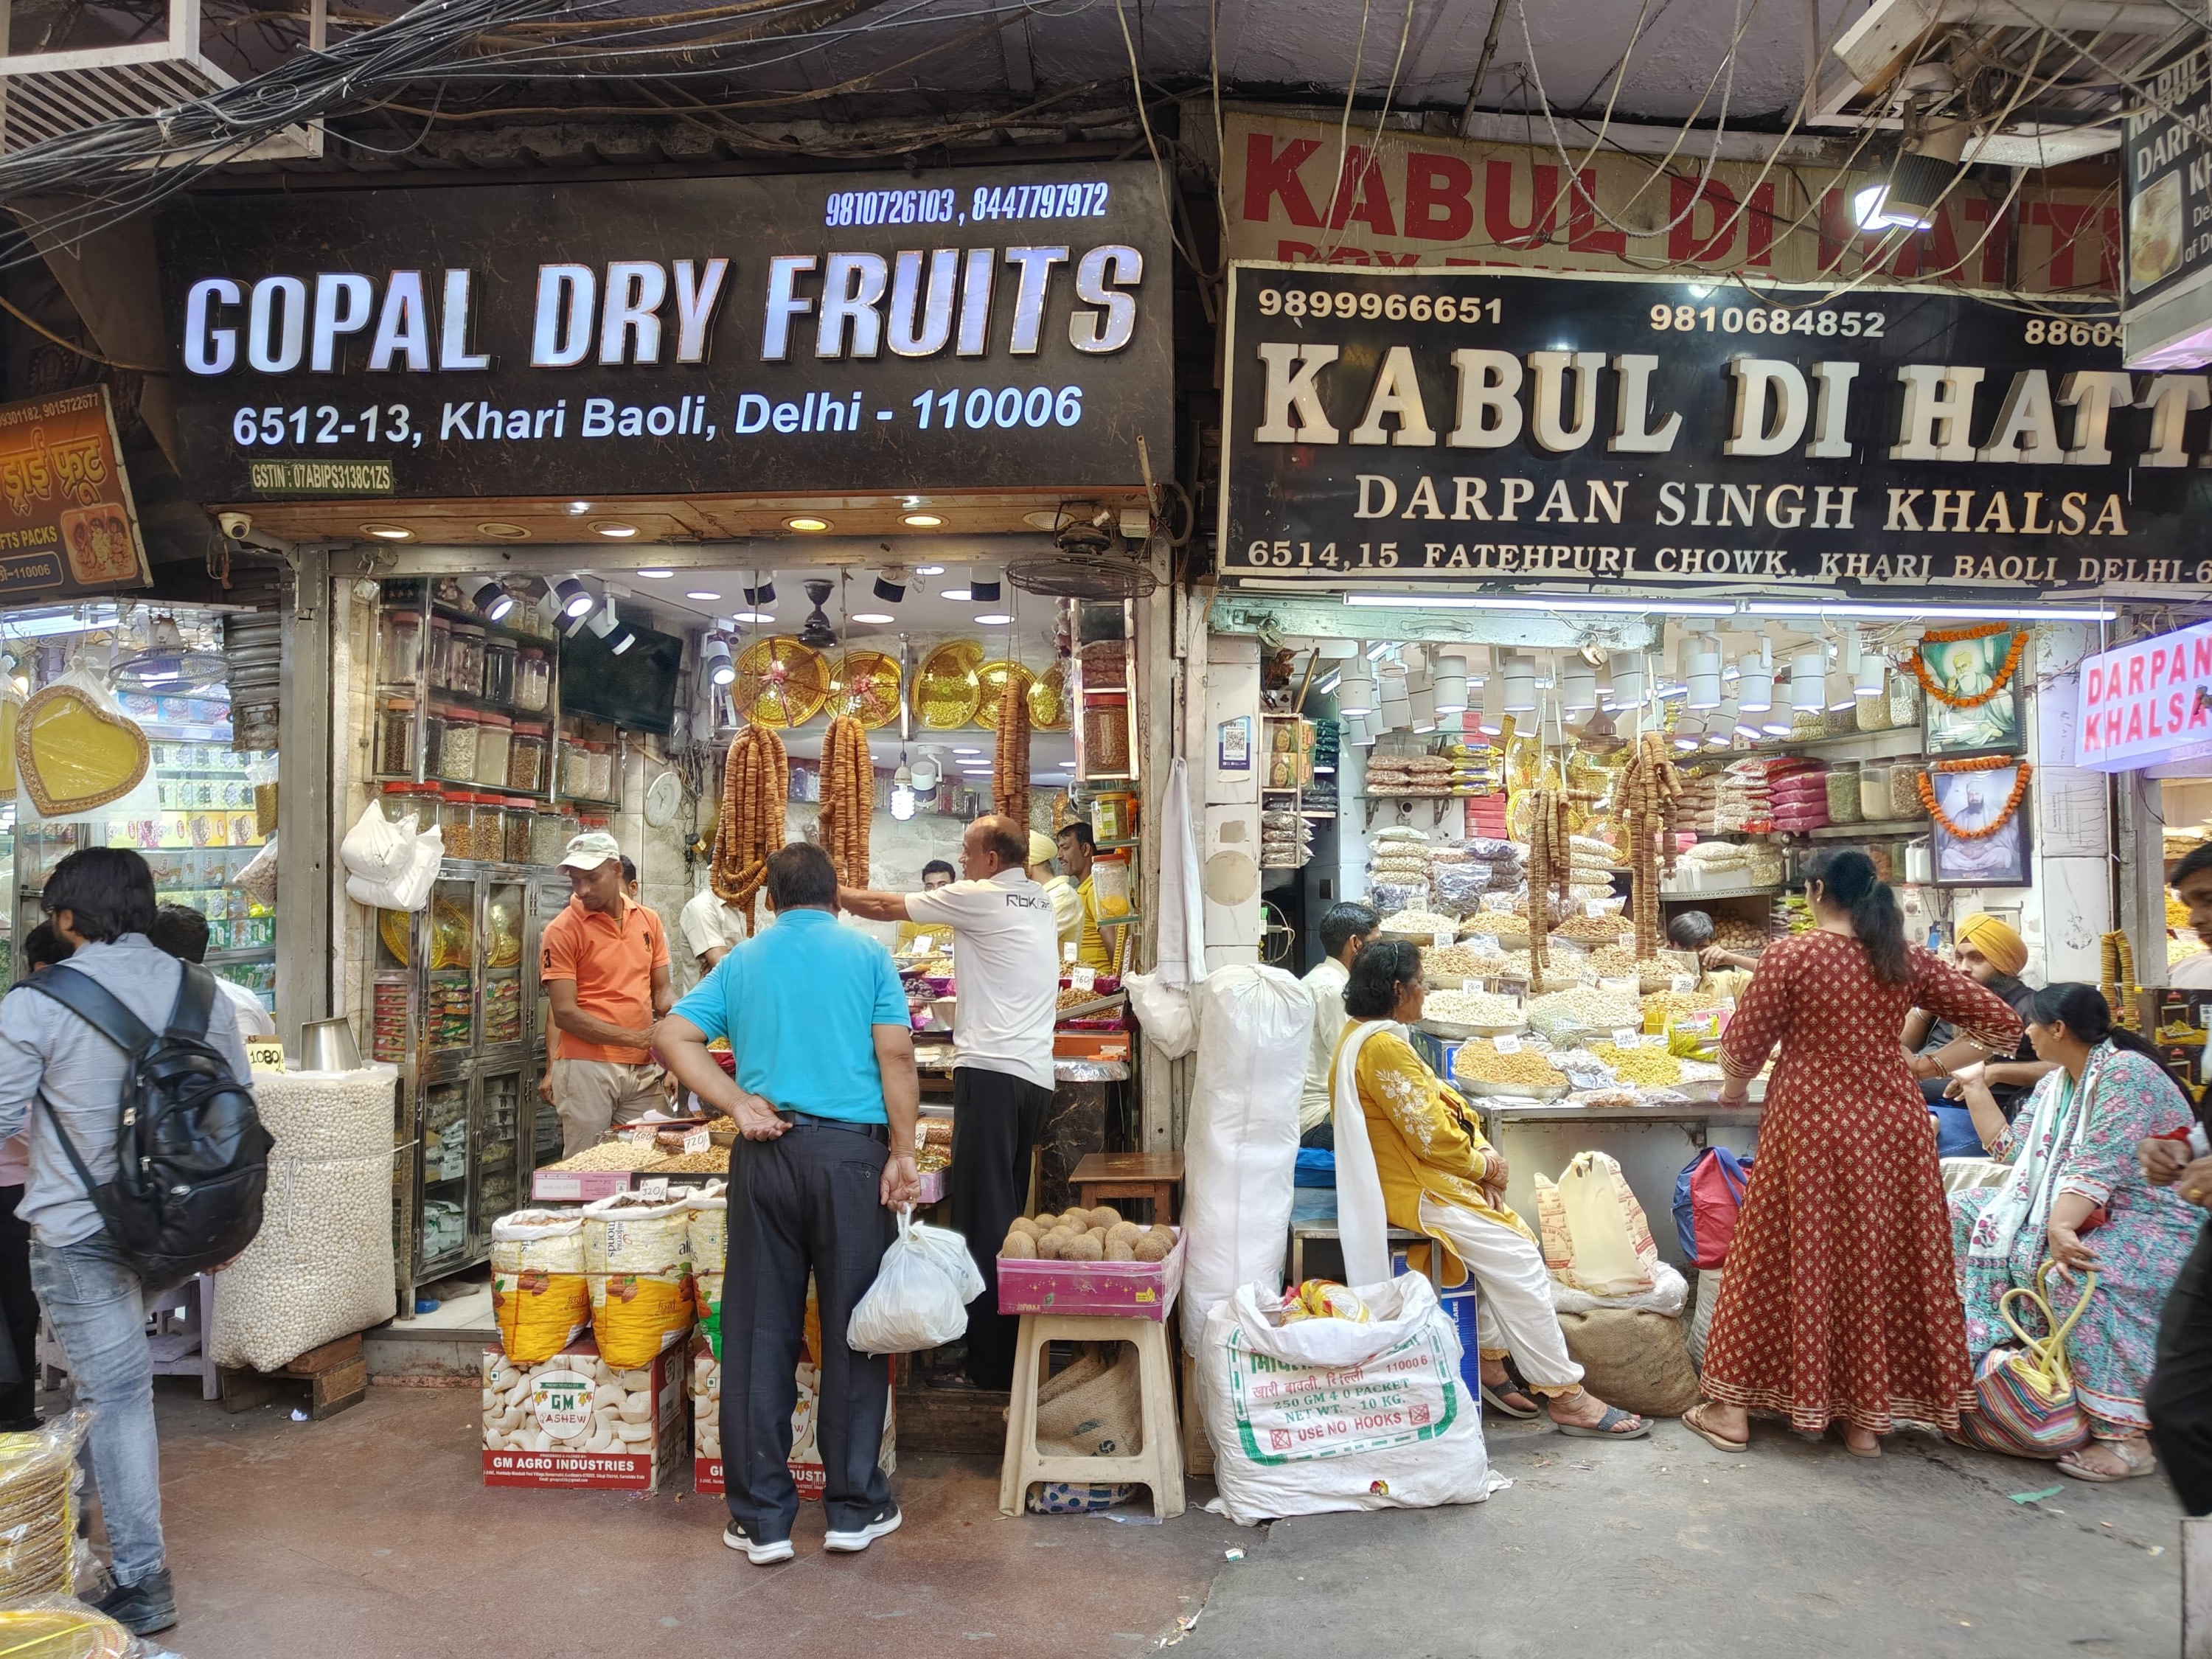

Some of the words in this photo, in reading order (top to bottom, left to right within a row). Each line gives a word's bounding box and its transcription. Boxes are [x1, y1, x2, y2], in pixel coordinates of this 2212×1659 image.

[971, 181, 1108, 223] 8447797972
[1243, 133, 1625, 254] KABUL
[1668, 175, 1776, 267] DI
[183, 268, 492, 375] GOPAL
[530, 257, 729, 367] DRY
[759, 245, 1144, 361] FRUITS
[1258, 288, 1503, 324] 9899966651
[1649, 303, 1886, 339] 9810684852
[233, 403, 421, 448] 6512-13,
[440, 399, 565, 441] Khari
[582, 394, 716, 441] Baoli,
[735, 390, 863, 434] Delhi
[876, 410, 893, 421] -
[911, 385, 1083, 430] 110006
[1254, 342, 1683, 453] KABUL
[1723, 358, 1860, 459] DI
[251, 465, 286, 489] GSTIN
[1353, 474, 1629, 524] DARPAN
[1655, 480, 1859, 530] SINGH
[1882, 487, 2129, 537] KHALSA
[21, 525, 58, 546] PACKS
[1248, 539, 1400, 571] 6514,15
[1424, 542, 1636, 574] FATEHPURI
[1820, 552, 1933, 579] KHARI
[2087, 634, 2212, 707] DARPAN
[2084, 692, 2207, 753] KHALSA
[1006, 894, 1038, 910] Rbk
[543, 948, 552, 969] 3
[1251, 1382, 1279, 1399] खारी
[1386, 1354, 1428, 1374] 110006
[1273, 1399, 1300, 1410] 250
[1304, 1394, 1325, 1405] GM
[1355, 1378, 1410, 1397] PACKET
[551, 1394, 574, 1413] GM
[1284, 1409, 1312, 1424] NET
[1360, 1399, 1377, 1411] 10
[1298, 1428, 1324, 1442] USE
[1328, 1421, 1347, 1436] NO
[1354, 1412, 1402, 1431] HOOKS
[493, 1457, 512, 1468] GM
[516, 1458, 552, 1470] AGRO
[556, 1458, 634, 1472] INDUSTRIES
